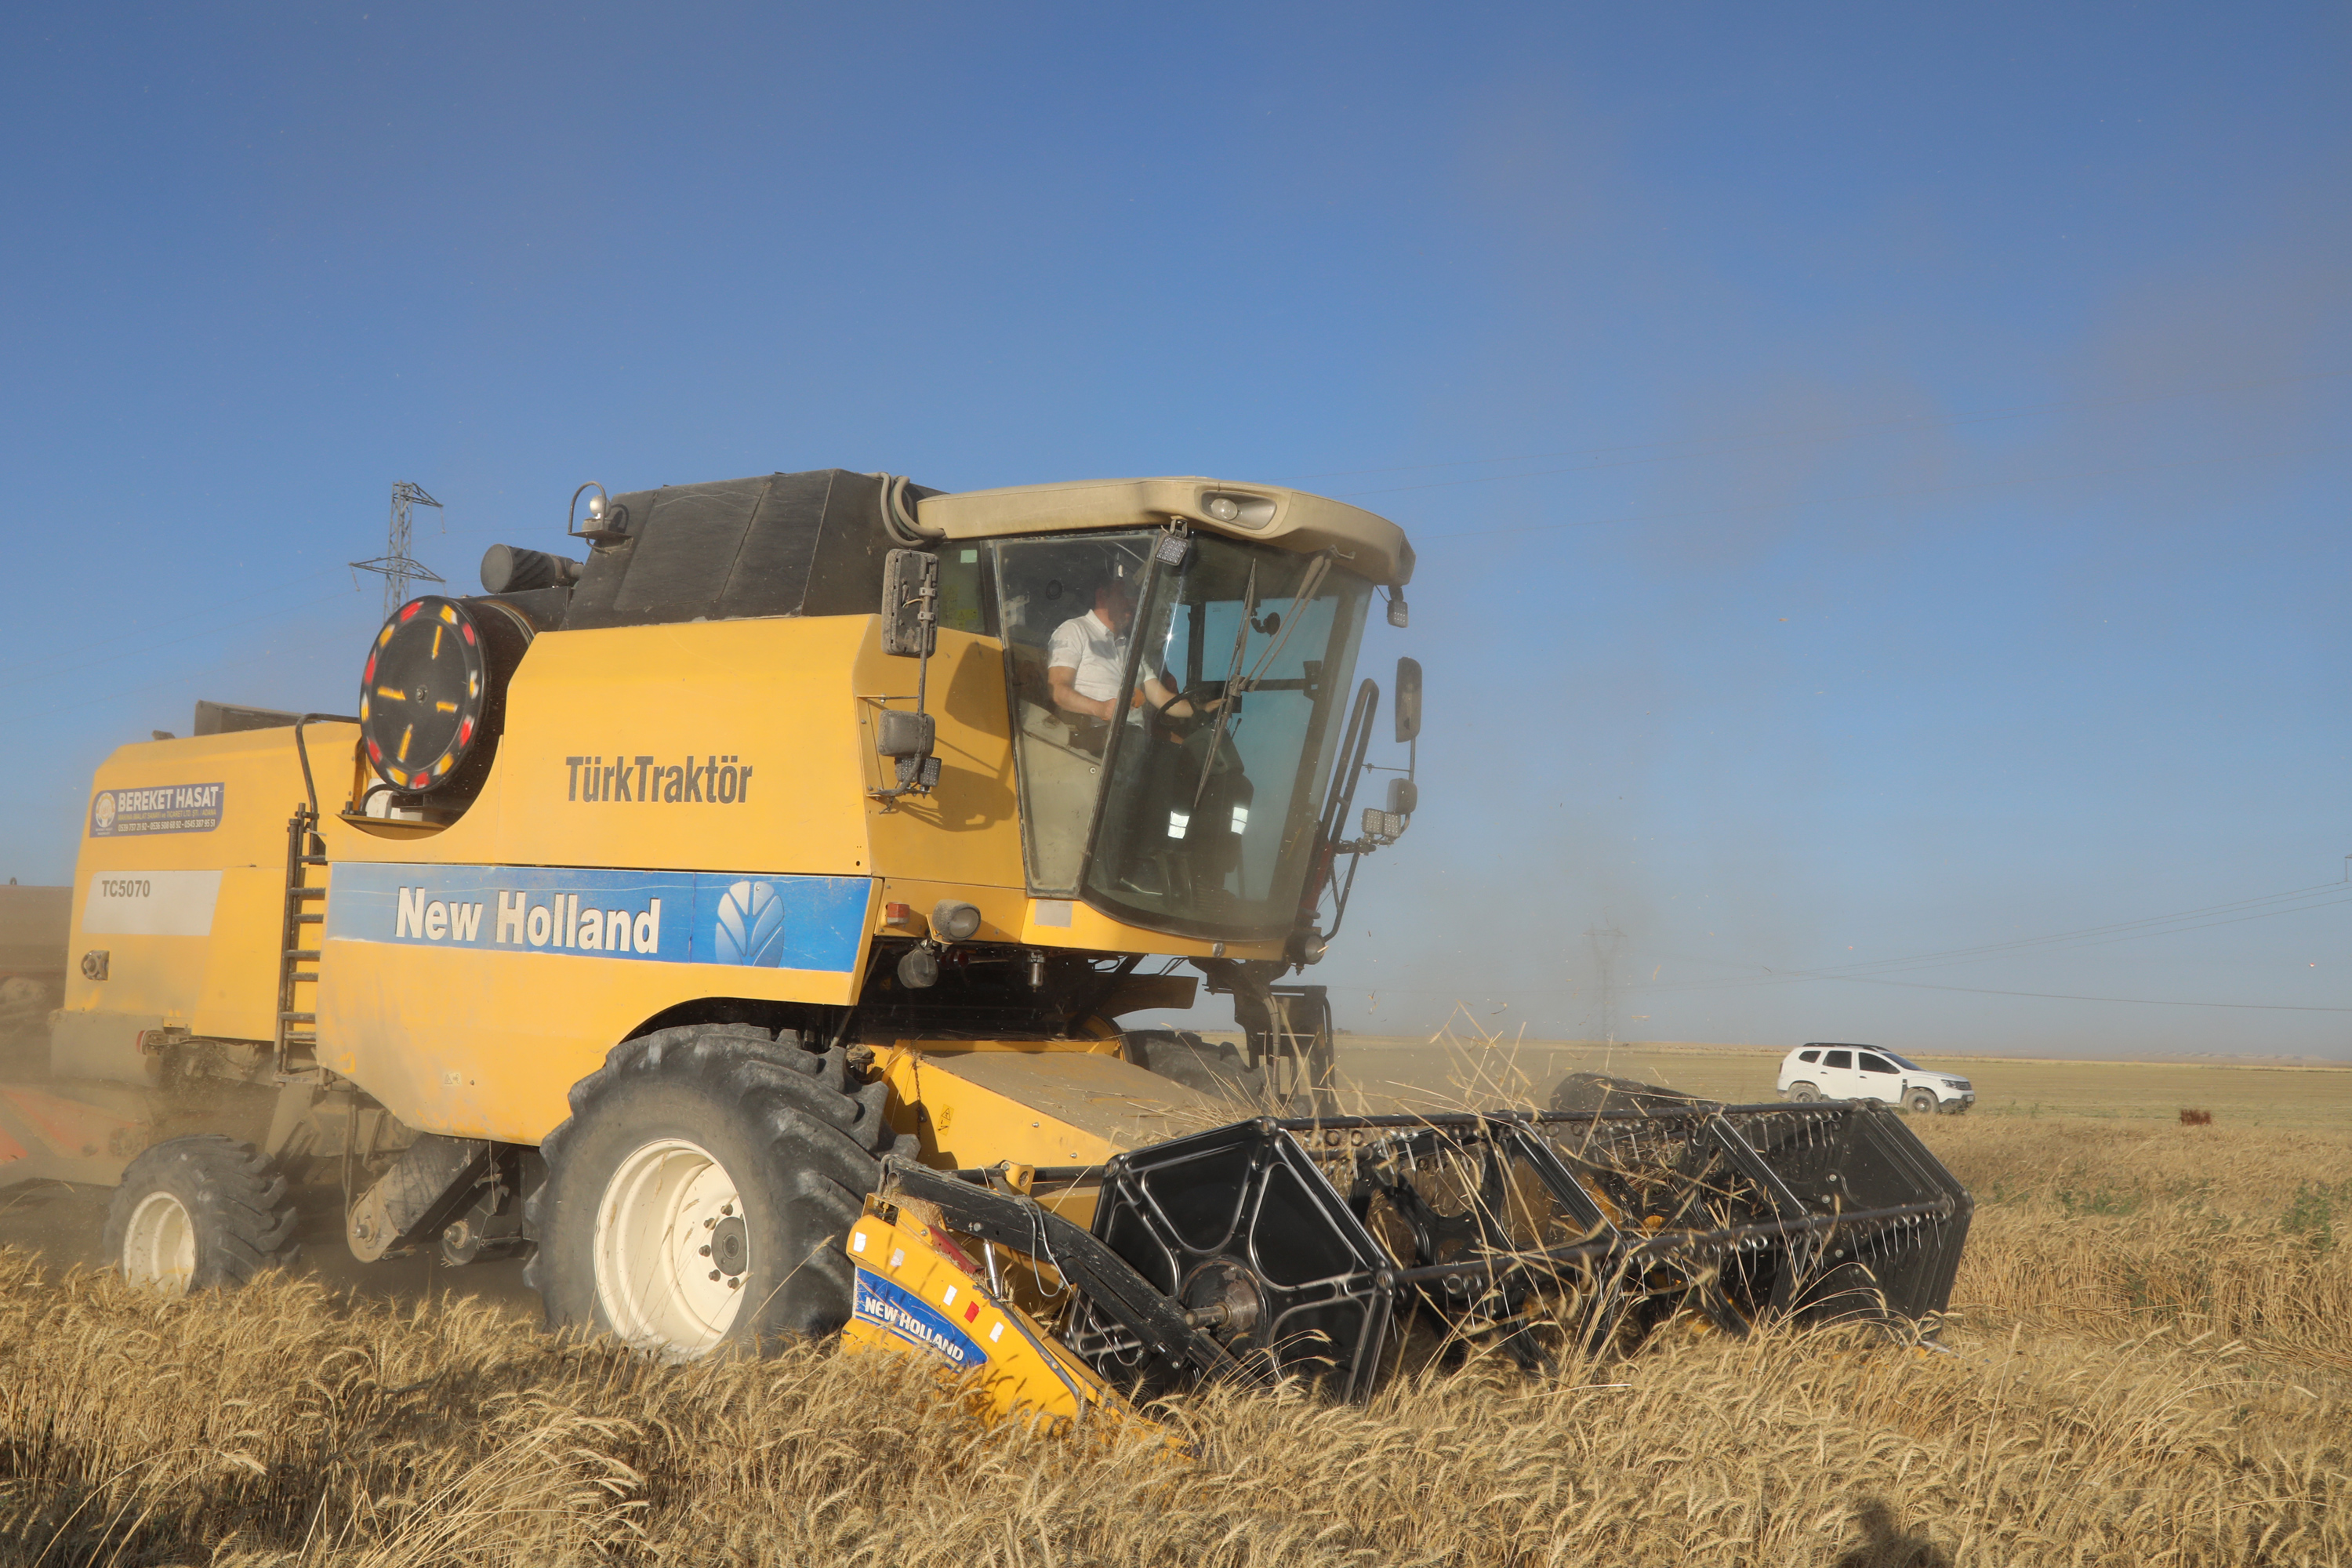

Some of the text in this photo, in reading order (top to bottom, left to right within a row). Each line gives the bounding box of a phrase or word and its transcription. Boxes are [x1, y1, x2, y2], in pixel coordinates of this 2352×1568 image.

[118, 786, 219, 812] BEREKET HASAT
[565, 755, 753, 804] TürkTraktör
[102, 880, 151, 898] TC5070
[395, 886, 659, 954] New Holland
[865, 1297, 964, 1362] NEW HOLLAND
